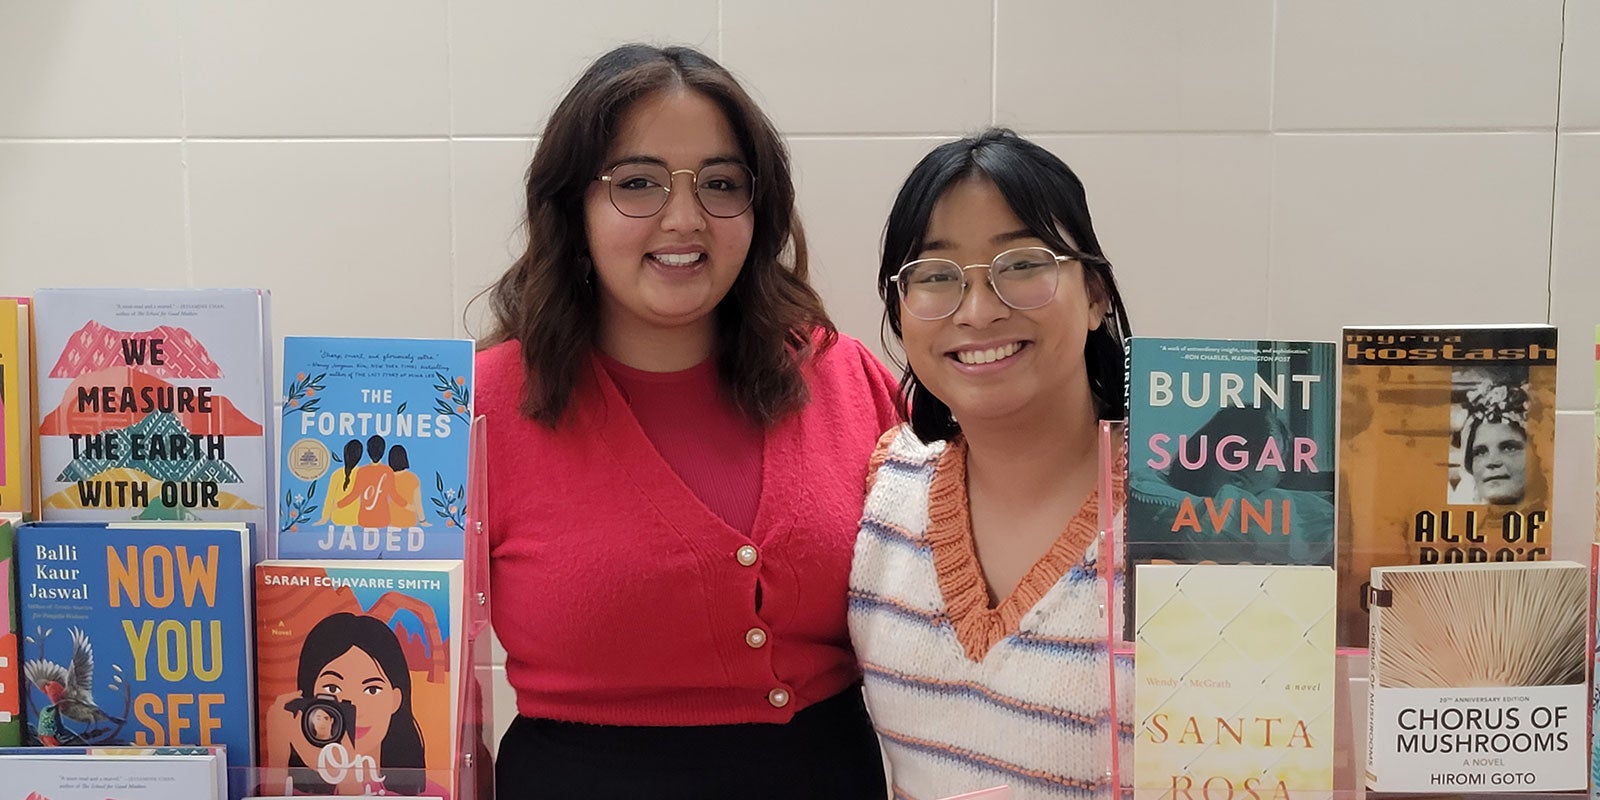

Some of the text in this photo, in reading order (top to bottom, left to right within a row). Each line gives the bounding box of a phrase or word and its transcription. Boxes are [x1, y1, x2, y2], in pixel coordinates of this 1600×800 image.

[121, 338, 164, 366] WE
[1346, 334, 1461, 344] myrna
[1346, 344, 1556, 360] kostash
[78, 386, 212, 414] MEASURE
[361, 389, 392, 404] THE
[1149, 371, 1321, 410] BURNT
[301, 411, 452, 438] FORTUNES
[69, 434, 226, 462] THE EARTH
[1146, 433, 1320, 473] SUGAR
[78, 480, 220, 508] WITH OUR
[364, 473, 387, 510] of
[1171, 496, 1291, 536] AVNI
[1414, 509, 1549, 544] ALL OF
[318, 525, 425, 552] JADED
[36, 544, 78, 561] Balli
[36, 564, 80, 581] Kaur
[106, 545, 220, 609] NOW
[264, 574, 441, 590] SARAH ECHAVARRE SMITH
[30, 583, 88, 600] Jaswal
[272, 628, 292, 637] Novel
[278, 620, 285, 628] A
[122, 619, 224, 682] YOU
[1146, 677, 1231, 689] Wendy McGrath
[1294, 682, 1321, 692] novel
[133, 693, 226, 746] SEE
[1150, 713, 1314, 748] SANTA
[1398, 706, 1568, 731] CHORUS OF
[1397, 732, 1569, 754] MUSHROOMS
[318, 742, 387, 785] On
[1463, 758, 1505, 767] A NOVEL
[1171, 775, 1291, 800] ROSA
[1430, 772, 1536, 786] HIROMI GOTO
